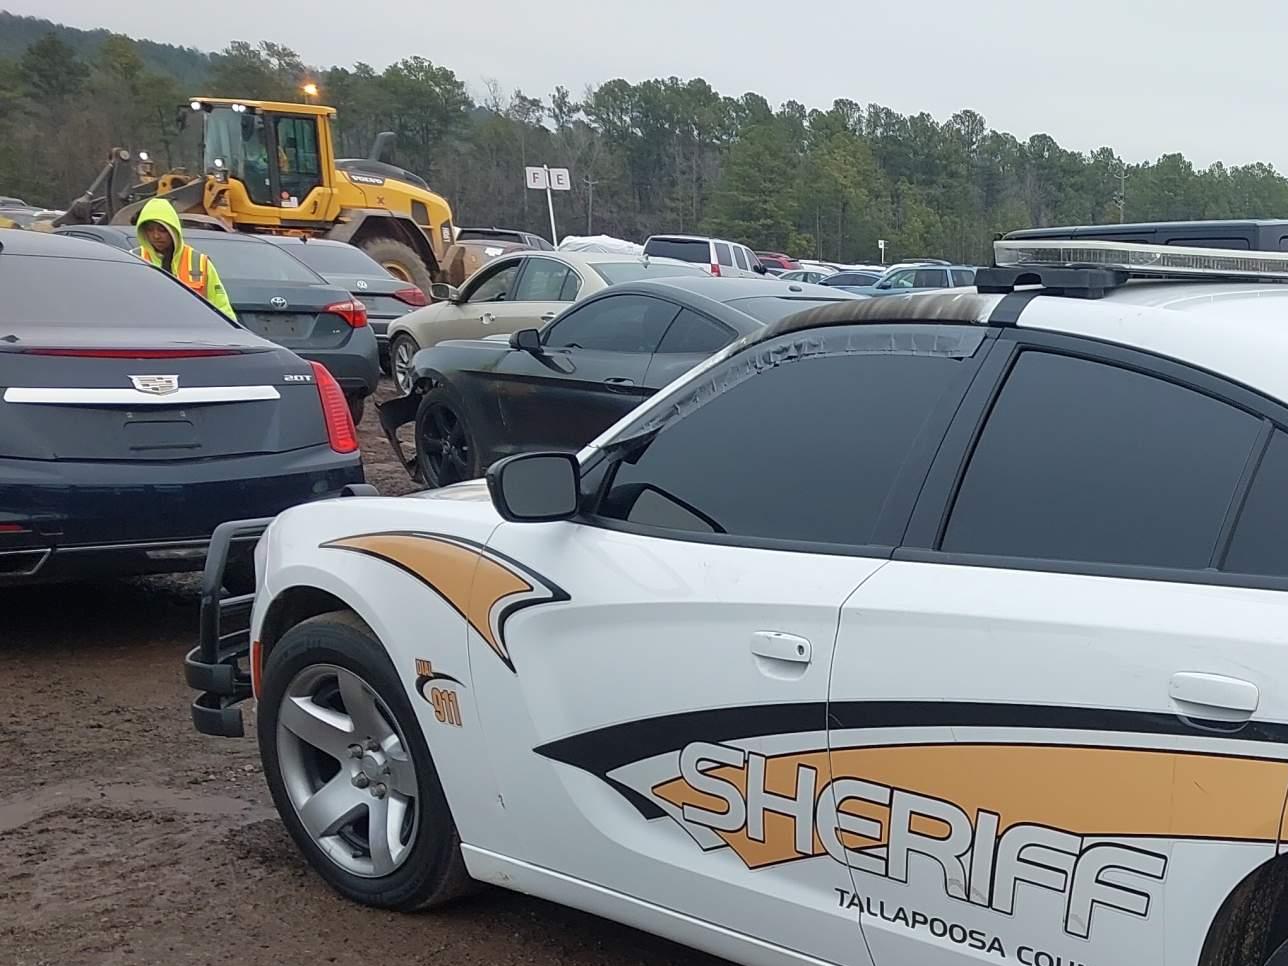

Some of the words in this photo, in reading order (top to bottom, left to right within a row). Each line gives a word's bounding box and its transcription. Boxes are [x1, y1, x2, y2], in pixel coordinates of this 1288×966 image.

[532, 172, 540, 183] F
[556, 174, 565, 185] E
[431, 687, 463, 727] 911
[679, 740, 1169, 940] SHERIFF
[834, 887, 1006, 959] TALLAPOOSA
